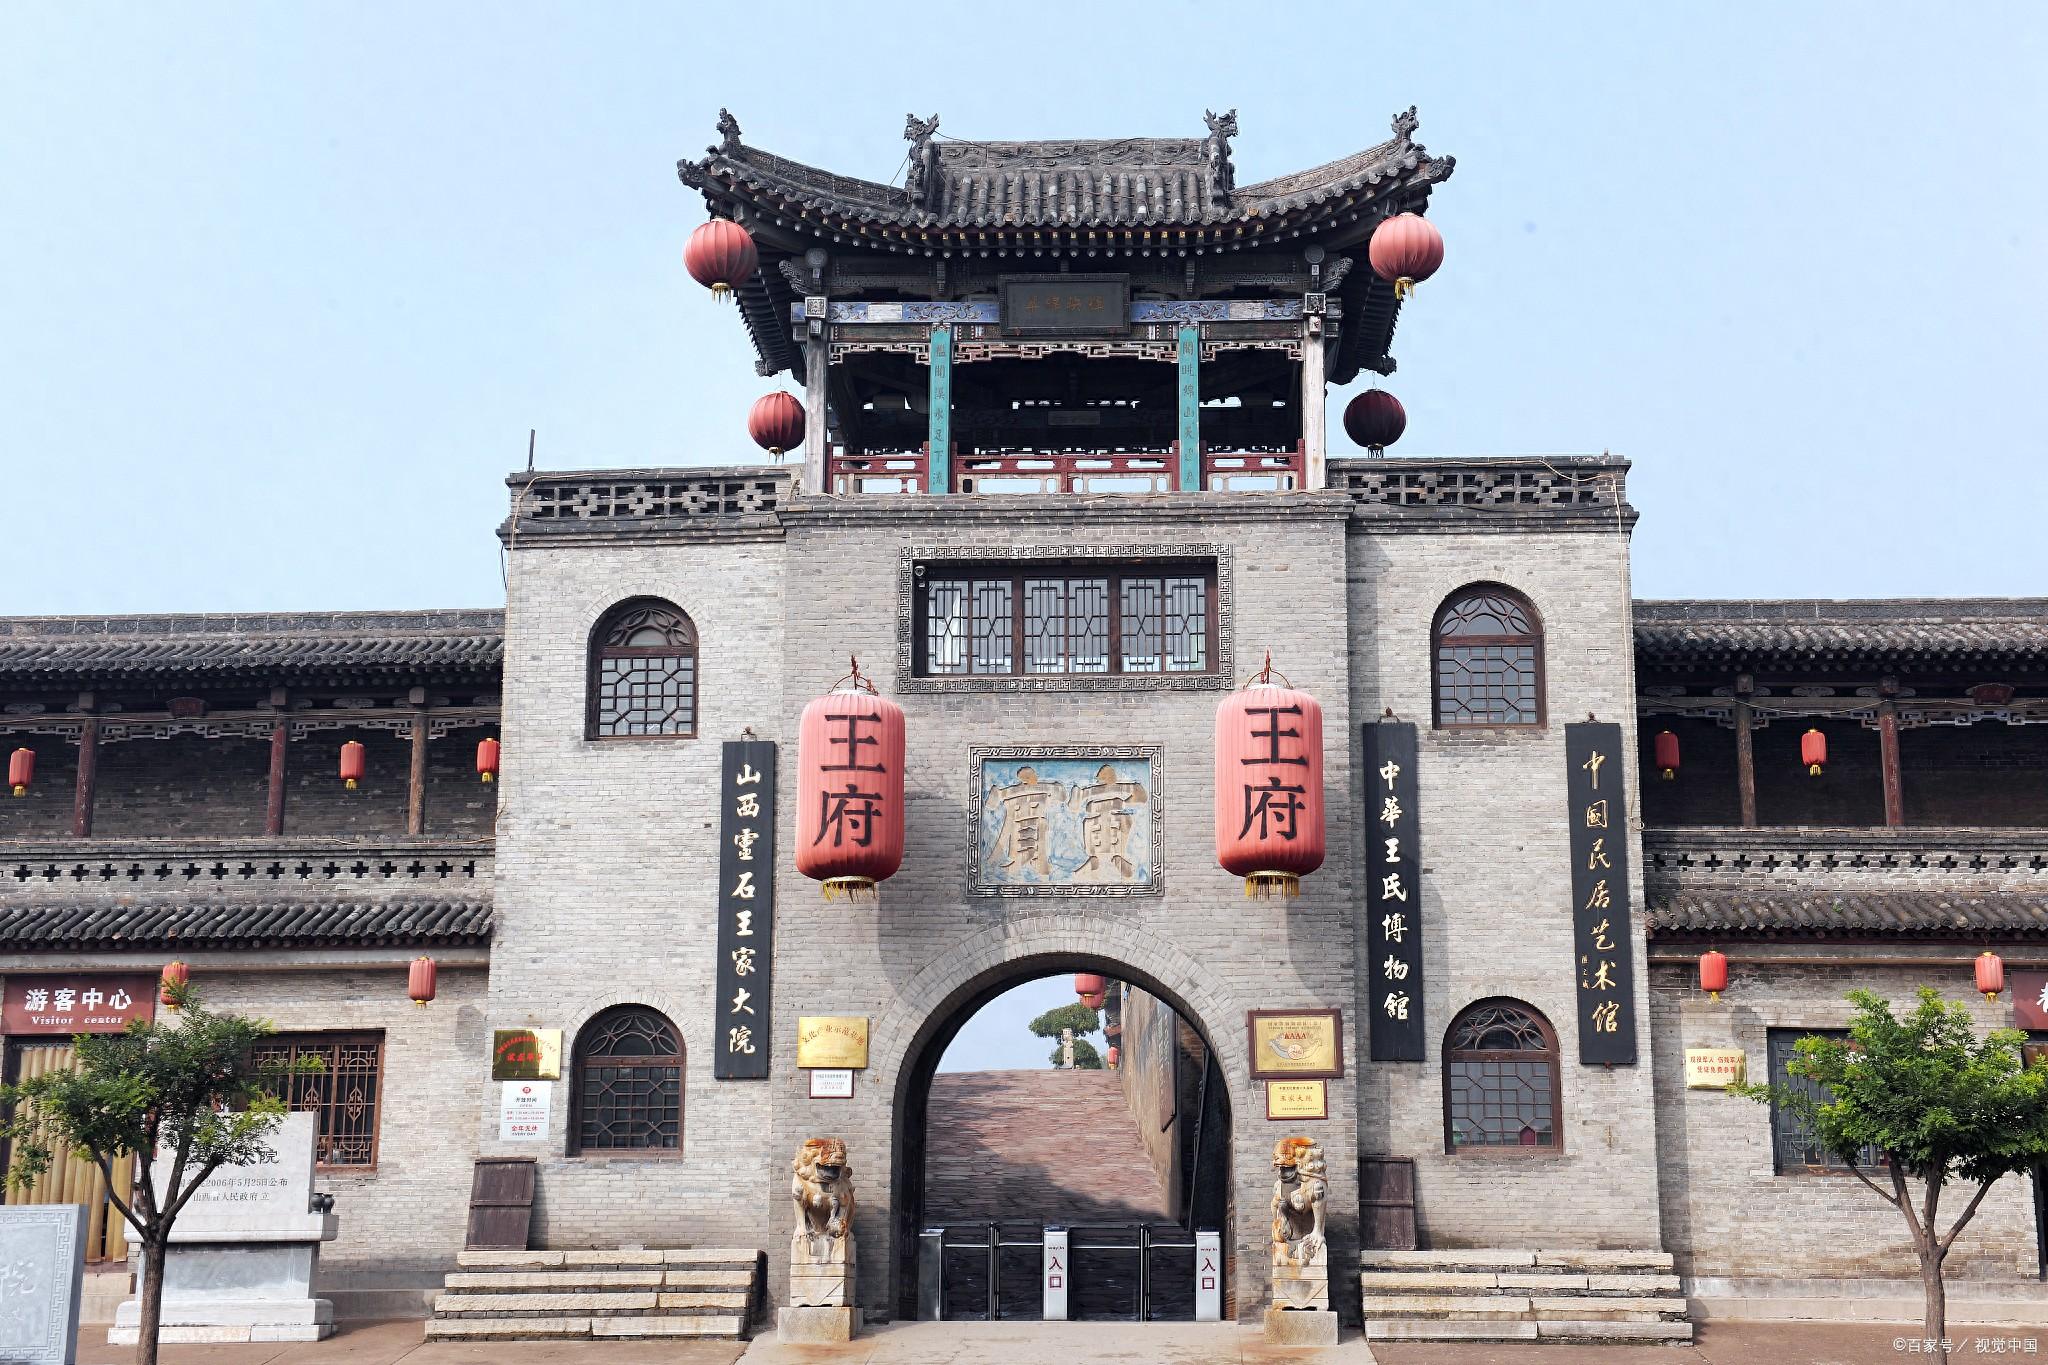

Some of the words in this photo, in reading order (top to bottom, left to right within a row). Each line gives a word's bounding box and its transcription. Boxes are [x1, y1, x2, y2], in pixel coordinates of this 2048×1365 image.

[813, 712, 887, 848] 王府
[1238, 703, 1309, 841] 王府
[24, 987, 133, 1012] 游客中心
[32, 1015, 74, 1025] Visitor
[1048, 1256, 1063, 1288] 入口
[1201, 1257, 1216, 1290] 入口
